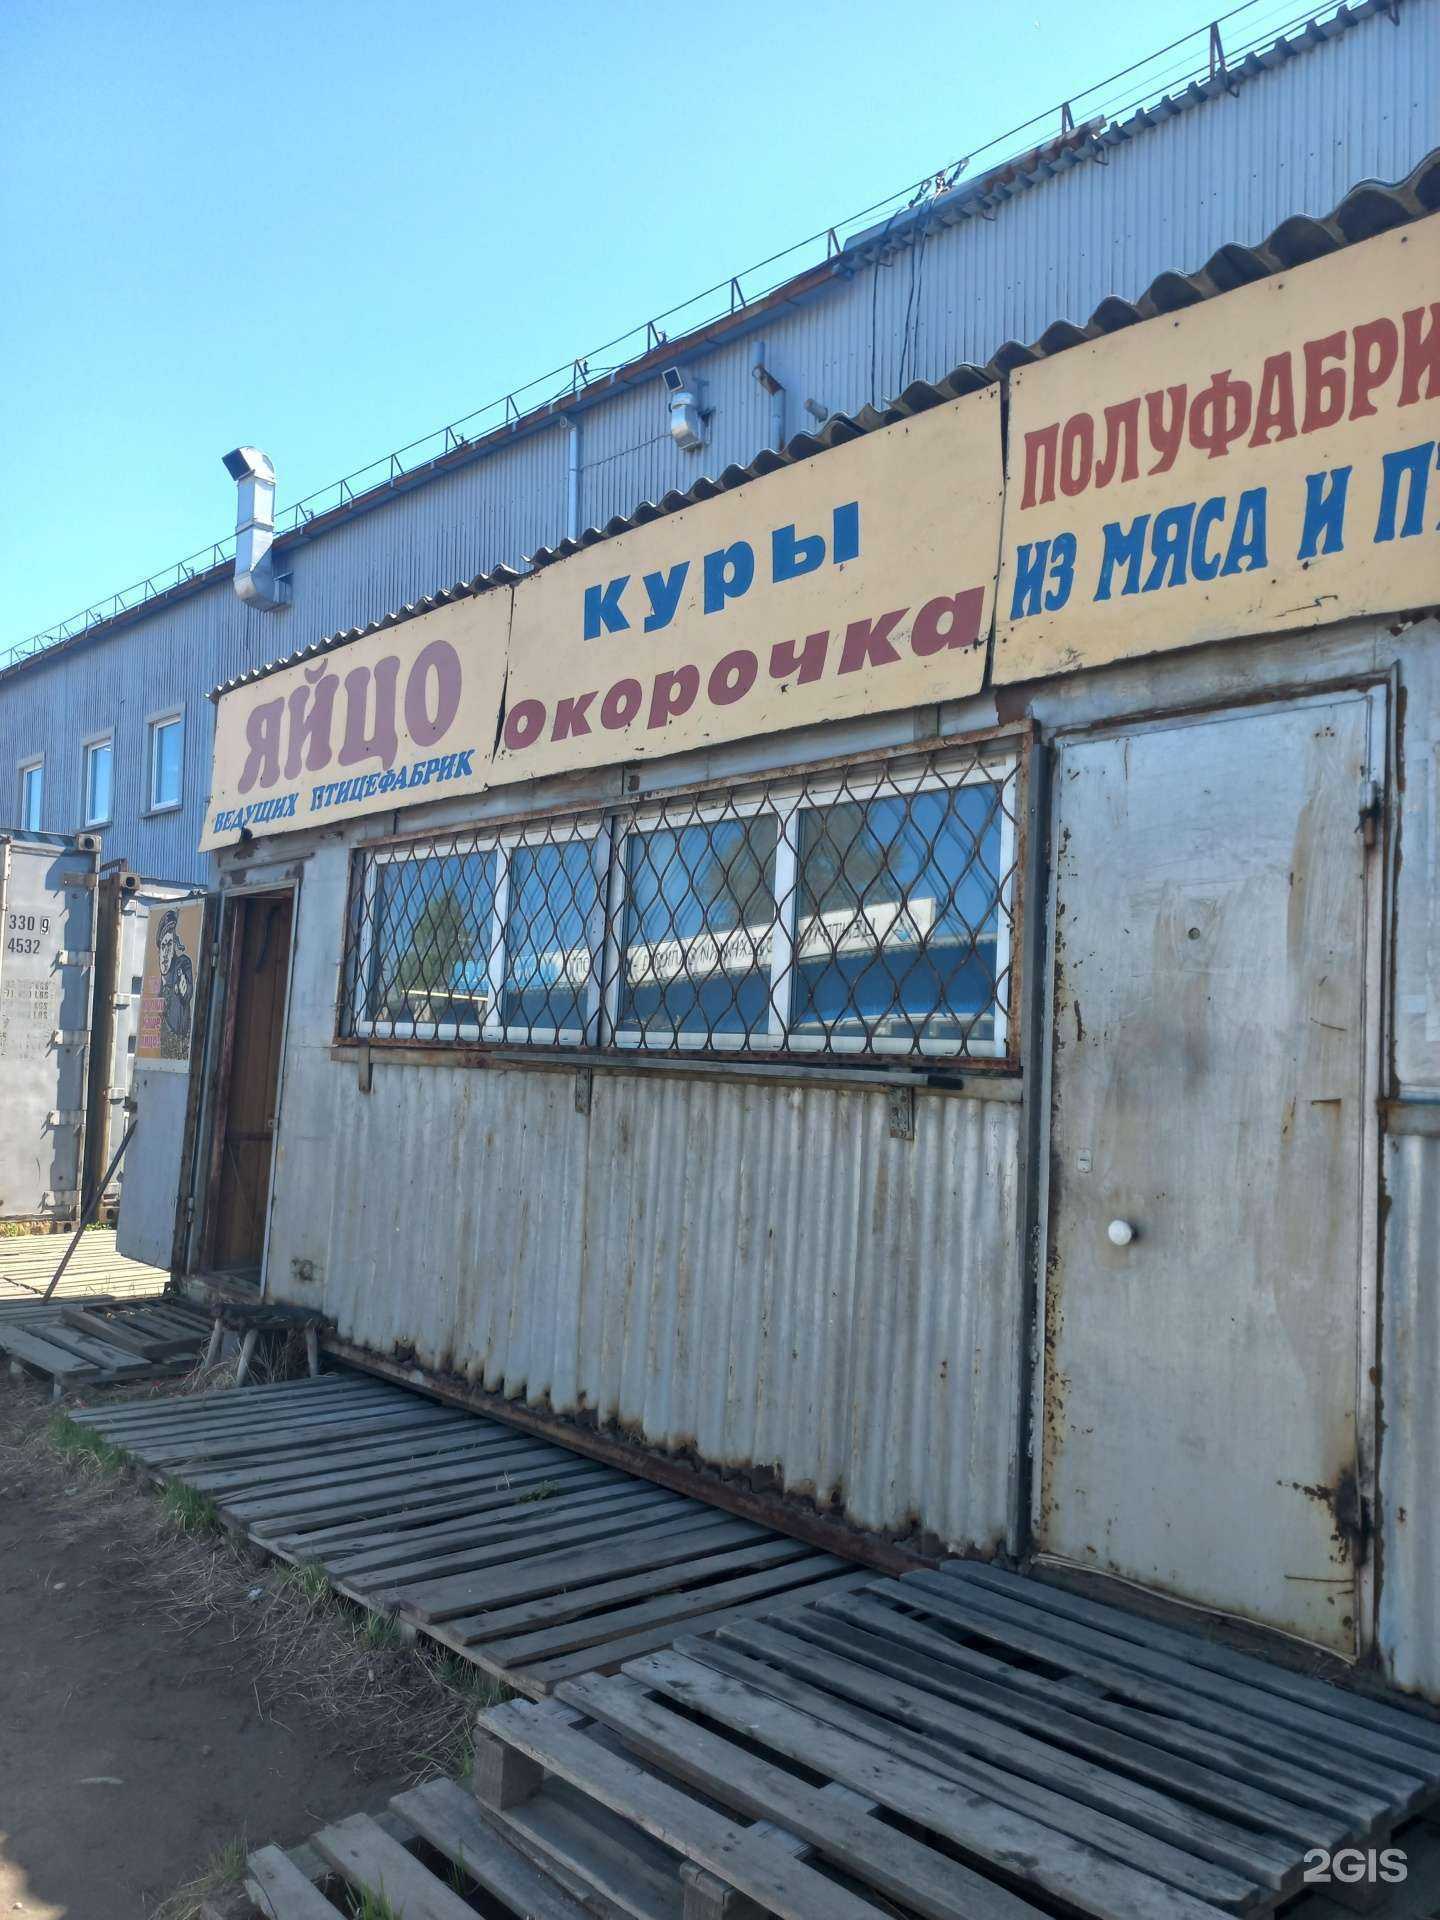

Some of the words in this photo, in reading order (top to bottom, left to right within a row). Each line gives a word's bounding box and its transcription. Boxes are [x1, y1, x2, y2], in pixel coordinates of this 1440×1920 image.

[1010, 532, 1077, 620] ИЗ
[1093, 486, 1269, 602] МЯСА
[1297, 465, 1353, 560] И
[1373, 440, 1440, 544] П
[238, 639, 462, 794] ЯЙЦО
[504, 586, 985, 750] окорочка
[213, 792, 299, 833] ВЕДУЩИХ
[310, 749, 475, 811] ПТИЦЕФАБРИК
[8, 937, 40, 954] 4532
[9, 914, 35, 931] 330
